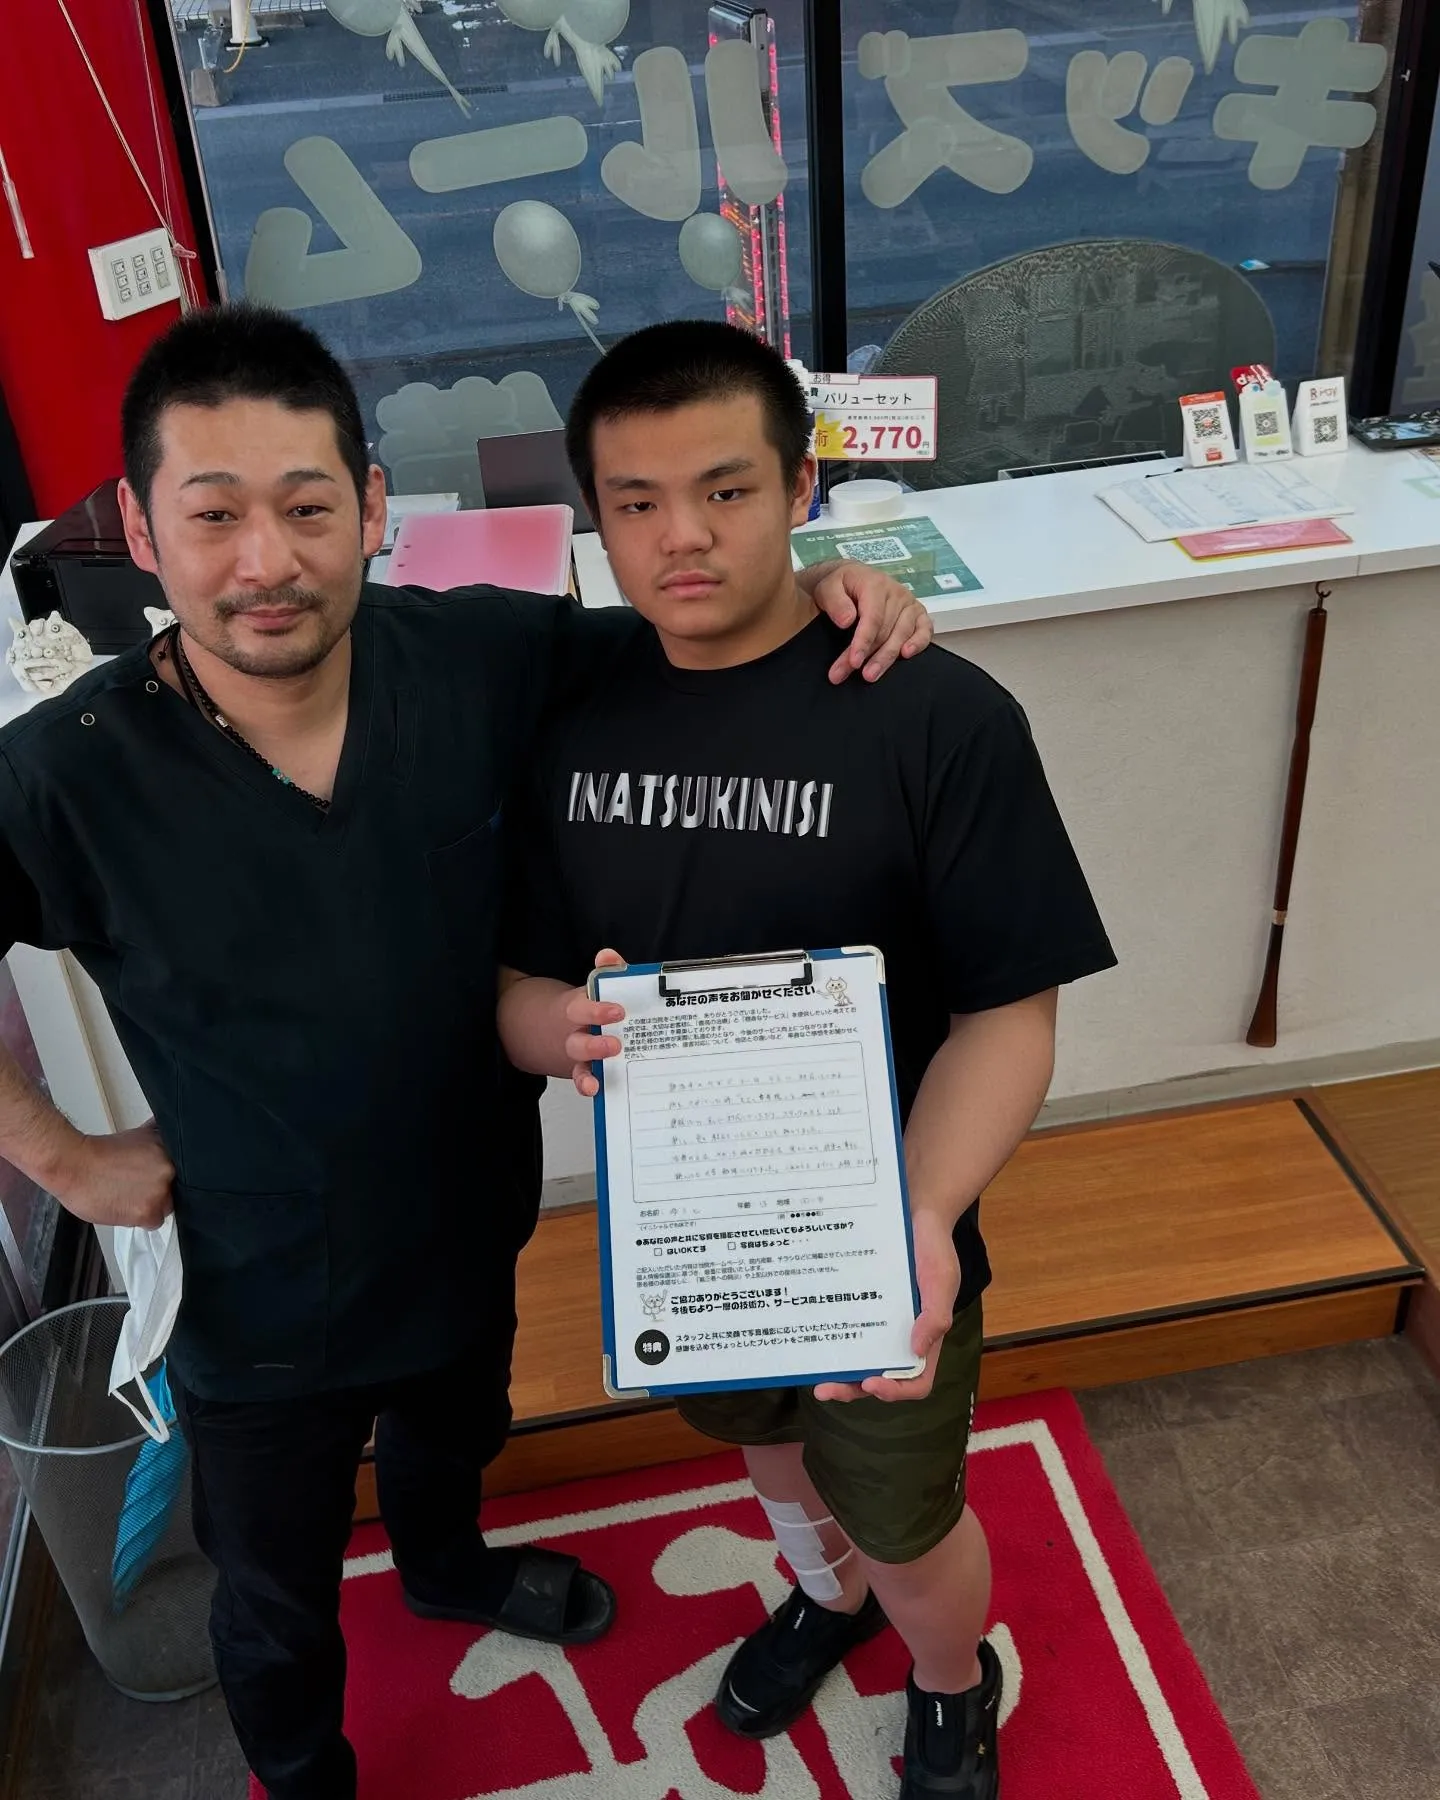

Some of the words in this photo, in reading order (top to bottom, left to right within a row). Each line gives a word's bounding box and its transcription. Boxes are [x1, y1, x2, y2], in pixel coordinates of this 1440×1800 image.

[824, 391, 912, 405] バリューセット
[567, 771, 834, 837] INATSUKINISI
[642, 1341, 663, 1354] 特典
